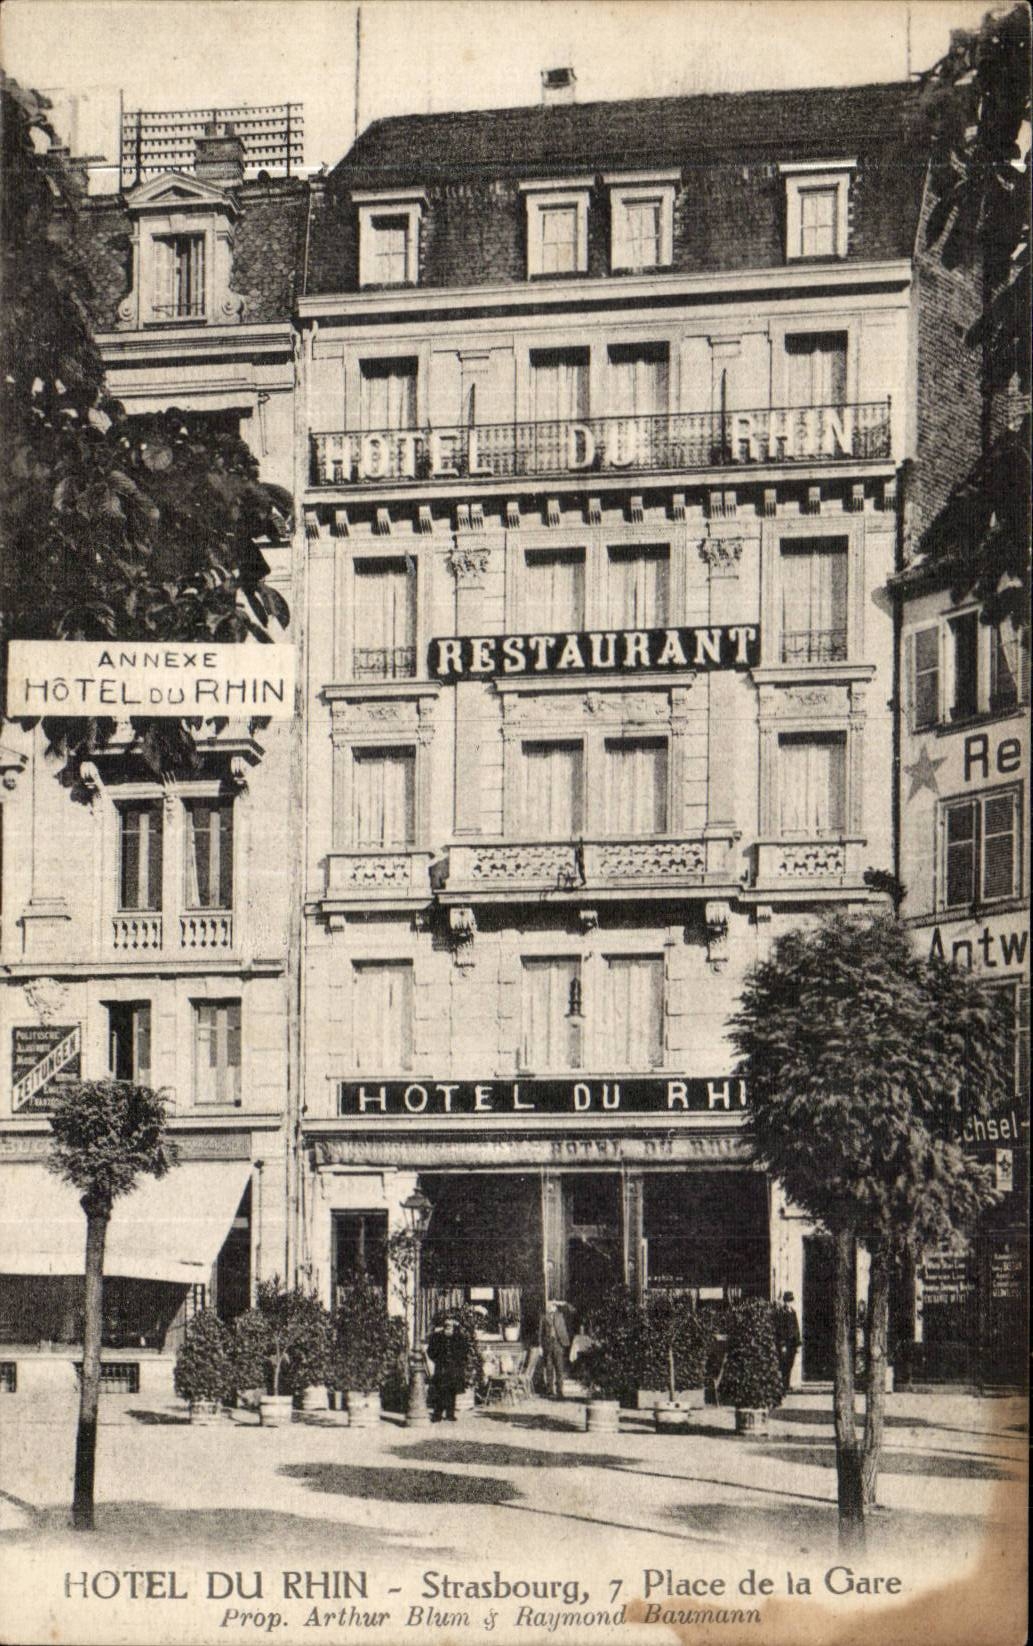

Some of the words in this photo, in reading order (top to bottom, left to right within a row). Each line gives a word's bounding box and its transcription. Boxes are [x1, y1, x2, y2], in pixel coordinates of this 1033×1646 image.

[323, 430, 493, 481] HOTEL
[567, 423, 638, 470] DU
[730, 408, 855, 462] RHIN
[98, 650, 218, 668] ANNEXE
[436, 626, 757, 675] RESTAURANT
[25, 677, 141, 705] HÔTEL
[150, 687, 185, 705] DU
[196, 678, 284, 704] RHIN
[963, 732, 1022, 783] Re
[928, 926, 1028, 970] Antw
[17, 1032, 77, 1104] ZEITUNGEN
[358, 1083, 535, 1113] HOTEL
[573, 1083, 620, 1111] DU
[666, 1079, 747, 1110] RHI
[956, 1110, 1029, 1142] chsel-
